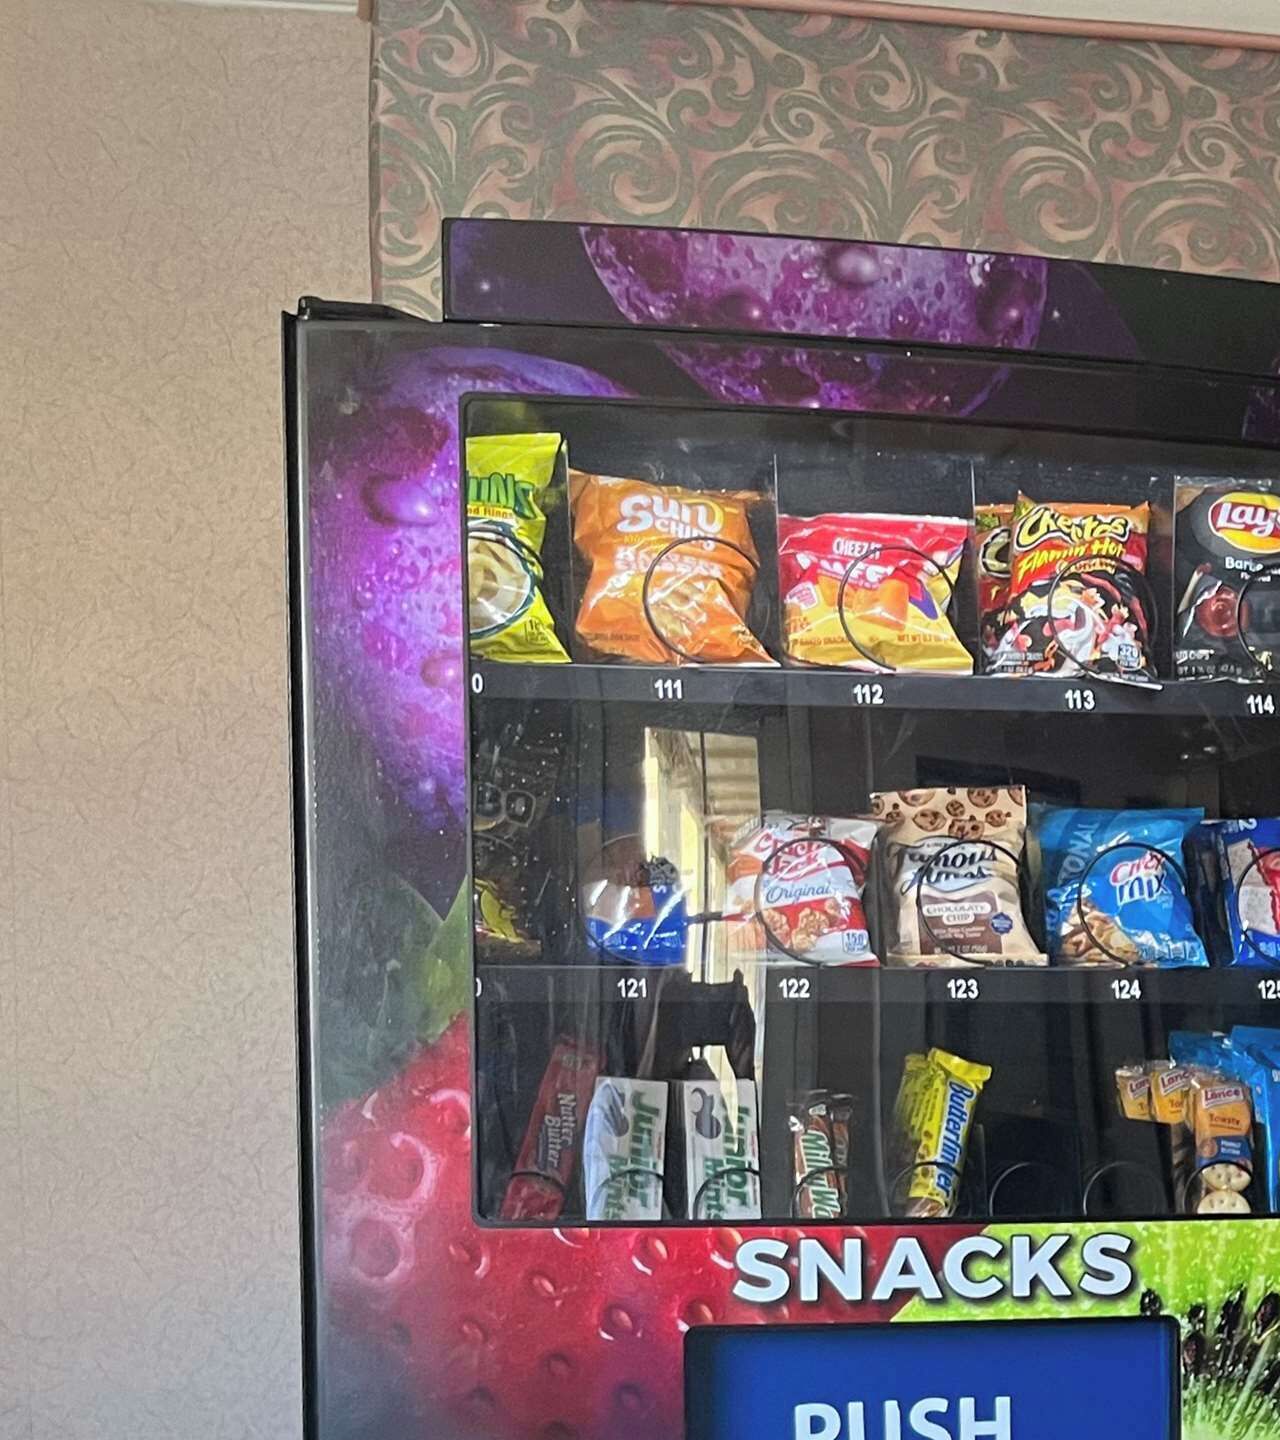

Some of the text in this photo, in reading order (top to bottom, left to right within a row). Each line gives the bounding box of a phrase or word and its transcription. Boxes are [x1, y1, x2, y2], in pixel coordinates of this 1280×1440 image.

[1017, 505, 1128, 547] Cheetos
[655, 678, 683, 700] 111
[853, 685, 884, 705] 112
[1065, 689, 1096, 710] 113
[1247, 695, 1275, 715] 114
[766, 881, 832, 904] Original
[926, 904, 988, 915] CHOCOLATE
[946, 914, 970, 923] CHIP
[617, 978, 648, 998] 121
[779, 978, 810, 999] 122
[947, 978, 979, 999] 123
[1111, 979, 1142, 999] 124
[1204, 1088, 1240, 1101] Lance
[558, 1092, 577, 1146] Nutter
[544, 1114, 563, 1168] Butter
[936, 1080, 975, 1197] Butterfiner
[733, 1233, 1134, 1302] SNACKS
